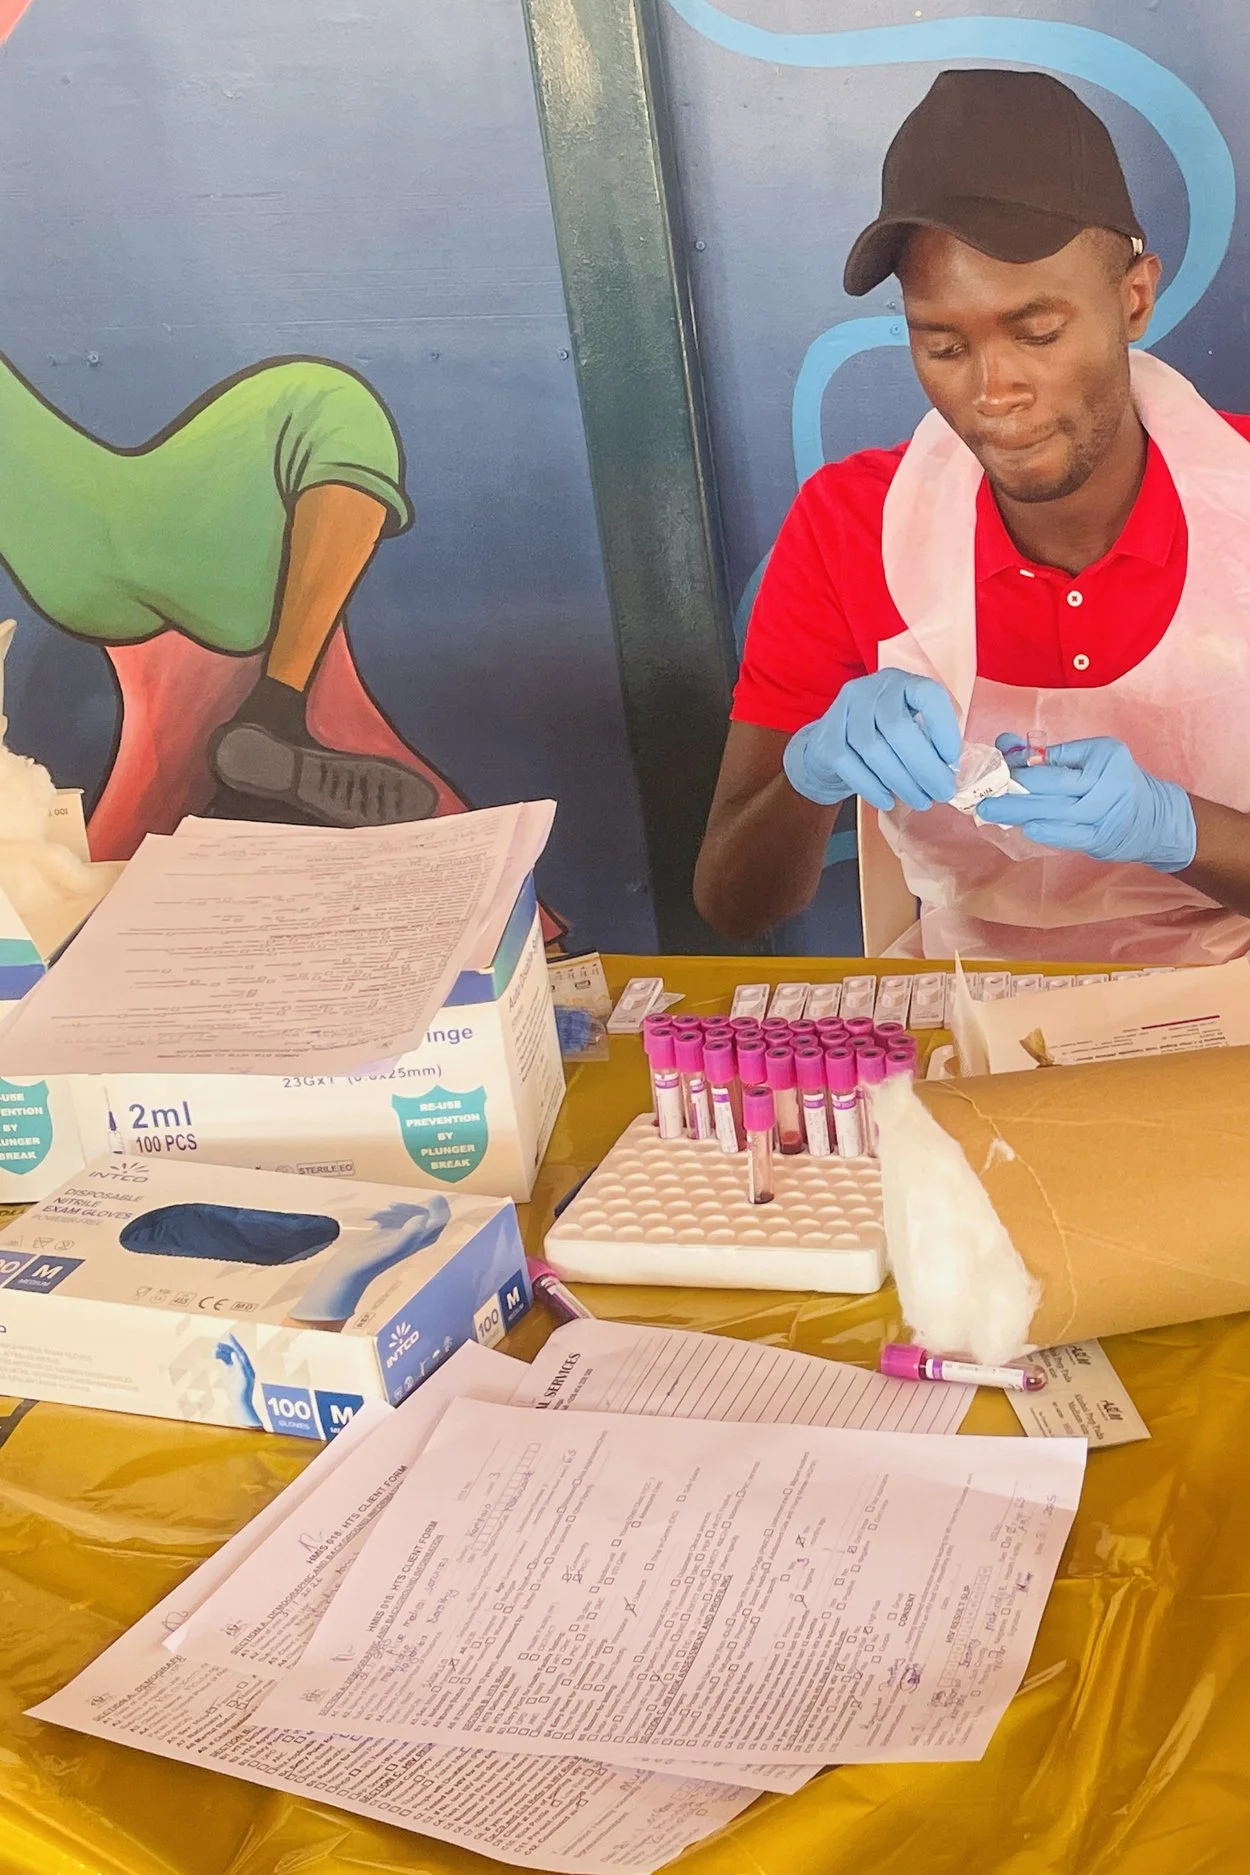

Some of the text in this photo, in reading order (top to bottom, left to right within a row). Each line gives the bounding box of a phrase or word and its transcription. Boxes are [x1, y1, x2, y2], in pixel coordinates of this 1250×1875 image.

[427, 1027, 473, 1045] inge
[420, 1100, 462, 1112] RE-USE
[129, 1101, 192, 1129] 2ml
[406, 1113, 480, 1127] PREVENTION
[3, 1124, 17, 1132] BY
[136, 1134, 197, 1153] 100 PCS
[437, 1132, 454, 1141] BY
[421, 1144, 476, 1156] PLUNGER
[299, 1165, 338, 1175] STERILE
[431, 1159, 471, 1170] BREAK
[89, 1170, 149, 1184] INTCO
[64, 1187, 146, 1203] DISPOSABLE
[42, 1205, 133, 1221] EXAM GLOVES
[32, 1264, 64, 1279] M
[478, 1308, 500, 1340] 100
[387, 1330, 420, 1369] INTCO
[544, 1354, 581, 1397] SERVICES
[268, 1398, 311, 1420] 100
[306, 1545, 328, 1564] HMIS
[342, 1513, 360, 1528] HTS
[358, 1487, 386, 1512] CLIENT
[384, 1465, 408, 1487] FORM
[368, 1611, 384, 1632] HMIS
[392, 1574, 406, 1590] HTS
[402, 1545, 423, 1573] CLIENT
[419, 1521, 438, 1544] FORM
[898, 1593, 916, 1627] CONSENT
